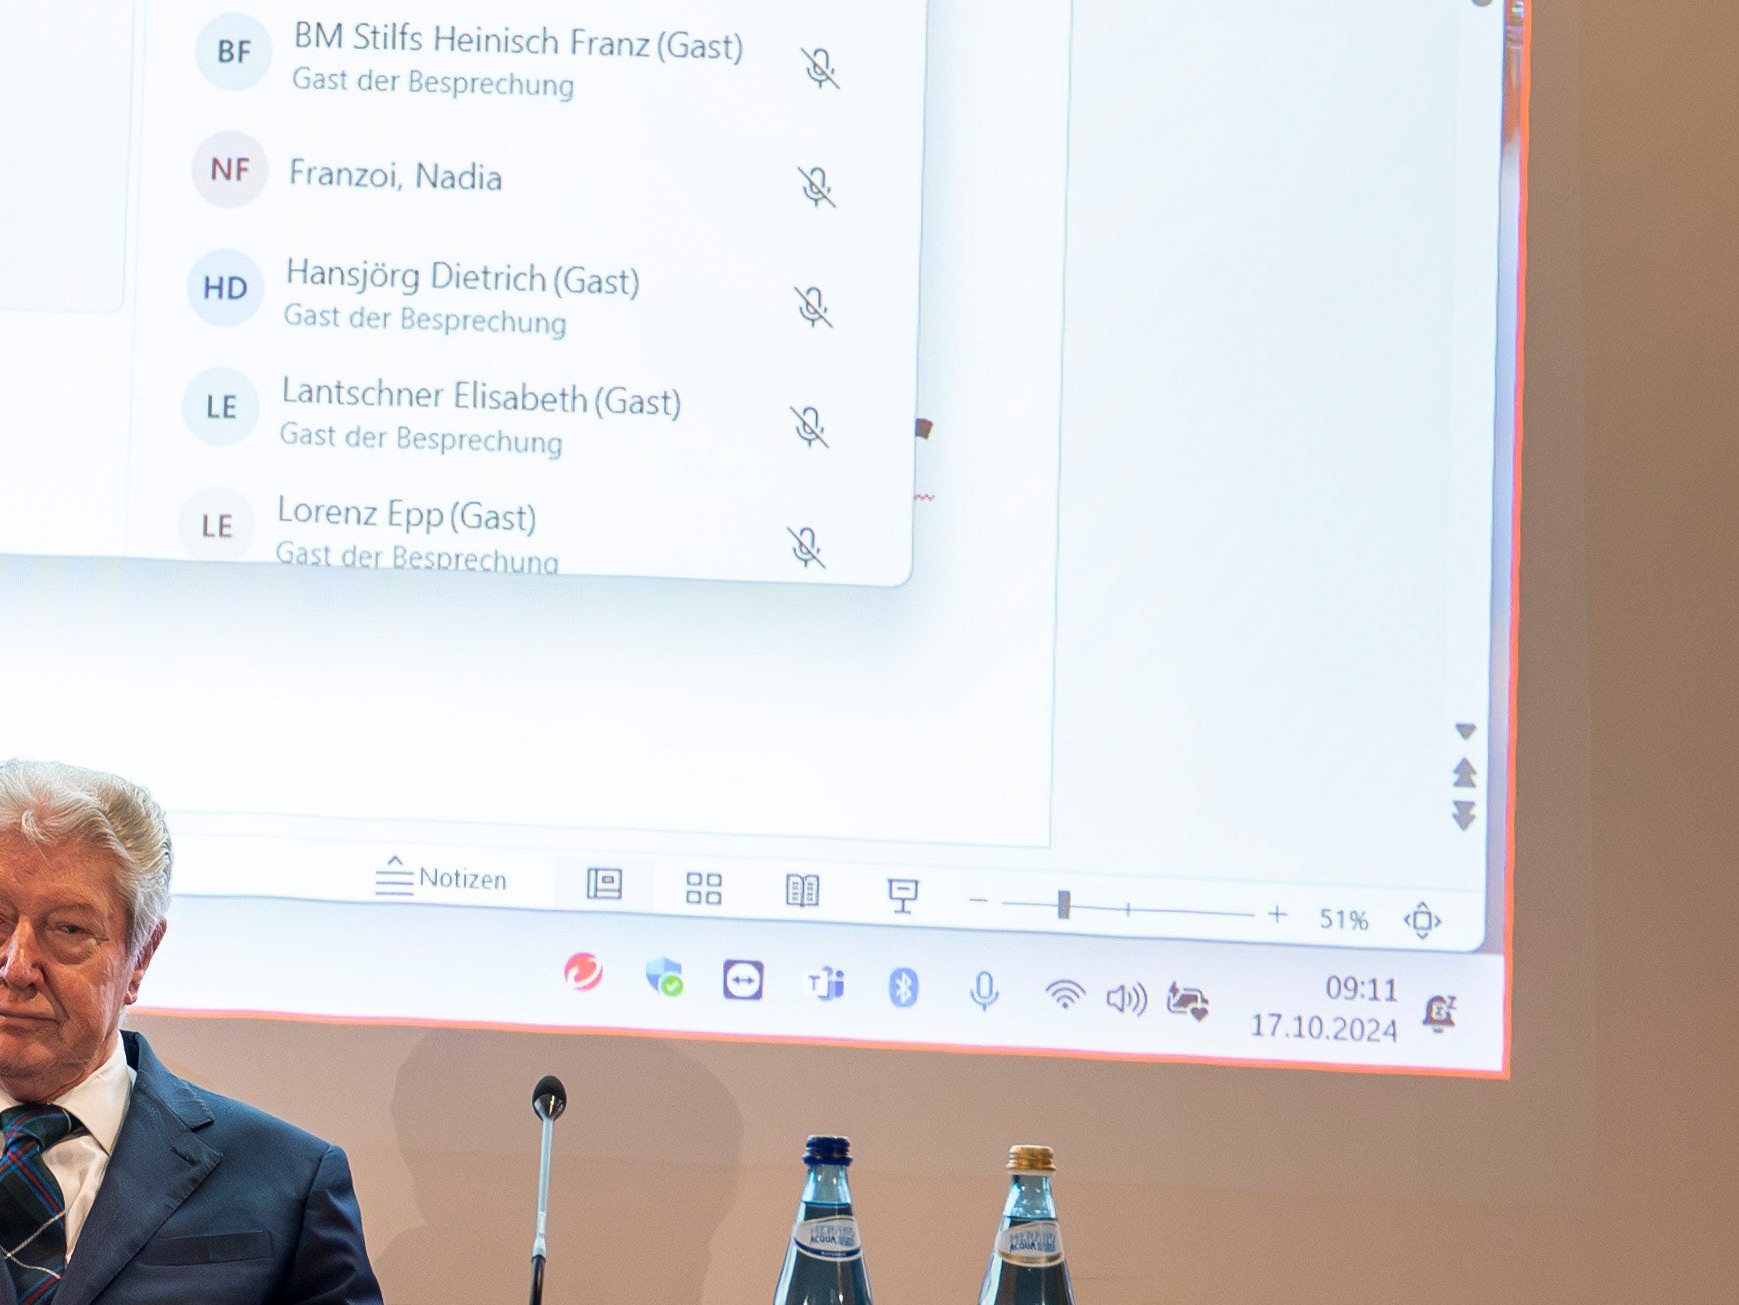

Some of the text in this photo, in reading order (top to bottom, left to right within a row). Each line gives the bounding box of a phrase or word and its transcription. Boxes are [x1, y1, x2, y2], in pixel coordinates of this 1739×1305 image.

[295, 23, 743, 64] BM Stilfs Heinisch Franz (Gast)
[290, 160, 502, 192] Franzoi, Nadia
[287, 258, 640, 300] Hansjörg Dietrich (Gast)
[283, 377, 681, 420] Lantschner Elisabeth (Gast)
[420, 867, 506, 891] Notizen
[1320, 908, 1369, 931] 51%
[1326, 976, 1397, 1002] 09:11
[1251, 1015, 1399, 1043] 17.10.2024
